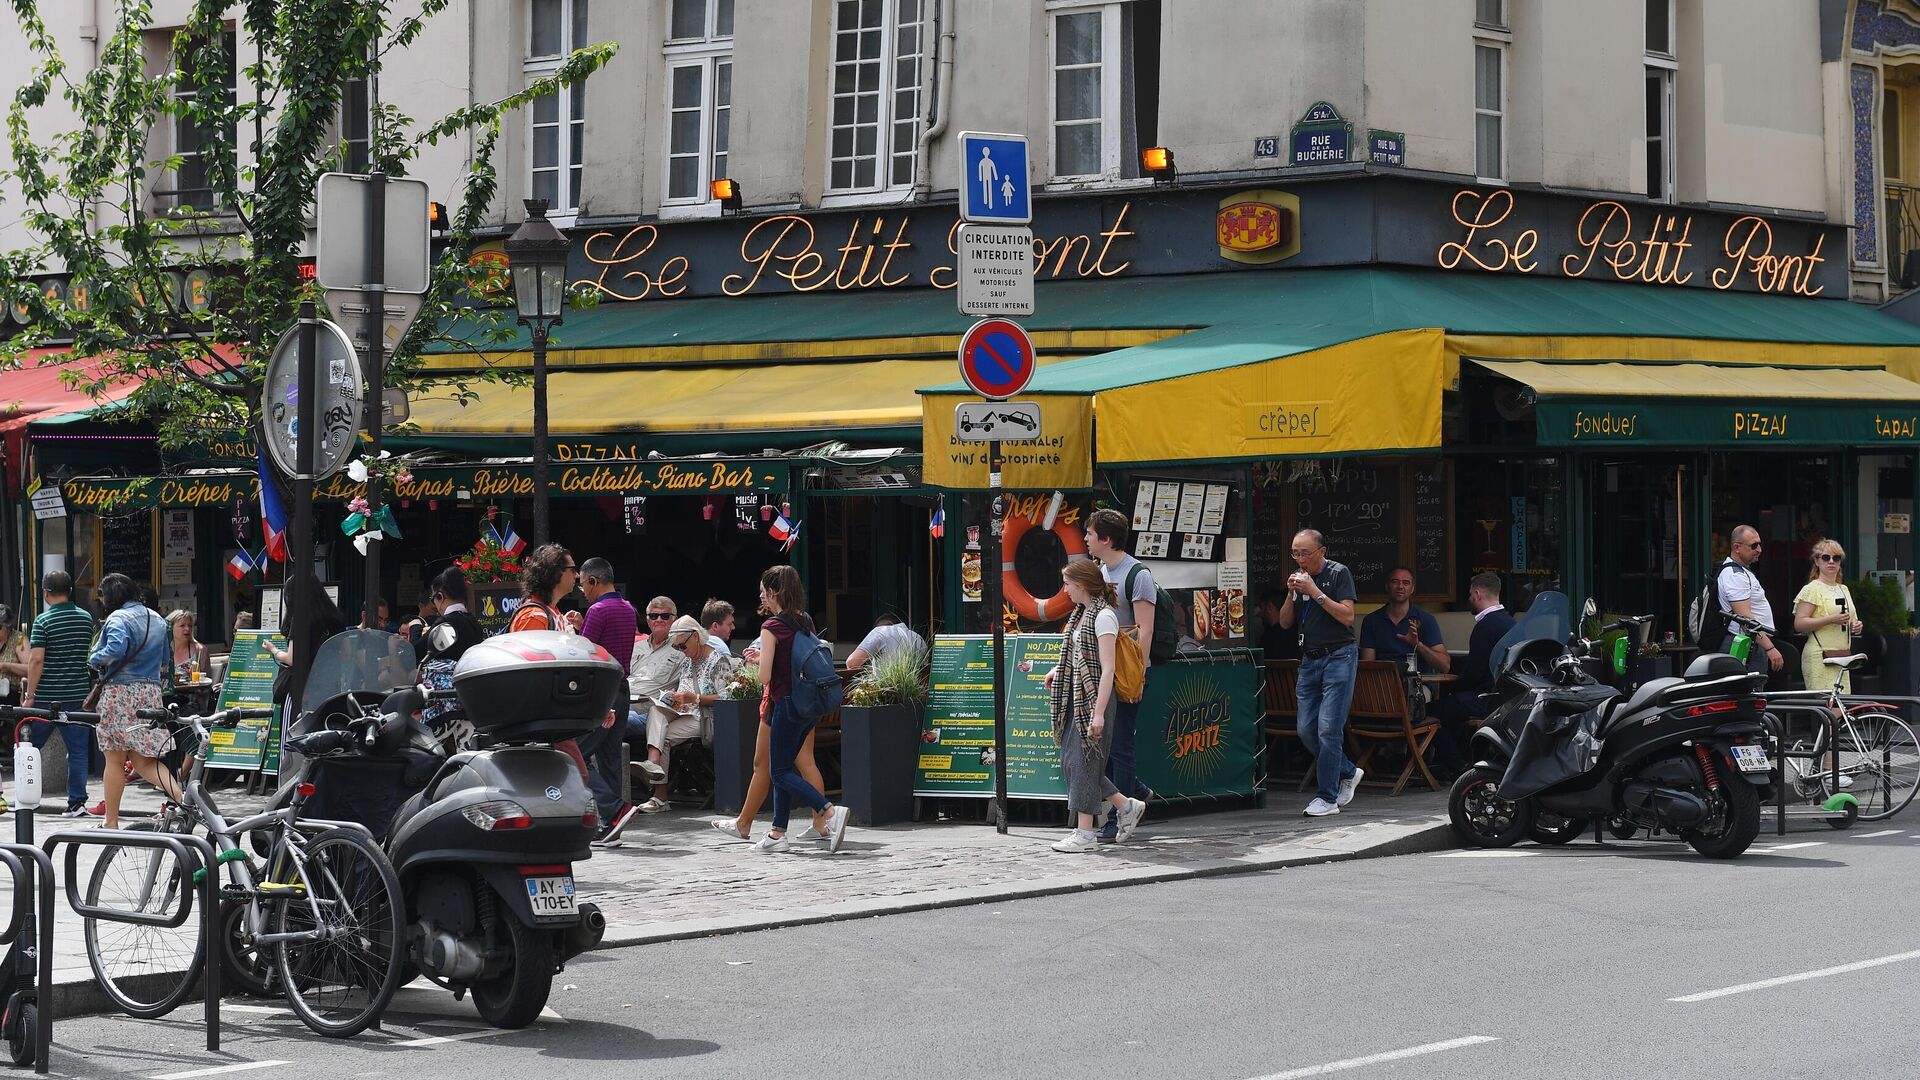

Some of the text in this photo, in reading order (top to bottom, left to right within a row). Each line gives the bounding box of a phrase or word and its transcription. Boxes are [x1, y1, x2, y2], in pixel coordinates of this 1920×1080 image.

[1311, 135, 1331, 146] RUE
[1378, 139, 1396, 151] RUE DU
[1258, 139, 1274, 155] 43
[1297, 149, 1344, 161] BUCHERIE
[1373, 152, 1401, 164] PETIT PONT
[965, 234, 1031, 246] CIRCULATION
[1438, 190, 1825, 296] Le Petit Pont
[571, 225, 689, 300] Le
[722, 215, 911, 296] Petit
[971, 249, 1025, 261] INTERDITE
[973, 266, 1023, 276] AUX VÉHICULES
[980, 278, 1017, 287] MOTORISÉS
[990, 290, 1007, 298] SAUF
[967, 301, 1029, 310] DESSERTE INTERNE
[1259, 406, 1319, 435] crêpes
[980, 452, 990, 464] d
[161, 480, 232, 506] Crêpes
[561, 465, 643, 493] Cocktails
[652, 463, 706, 490] Piano
[709, 461, 753, 489] Bar
[1516, 500, 1524, 570] CHAMPAGNE
[1163, 695, 1232, 744] APEROL
[1175, 725, 1220, 758] SPRITZ
